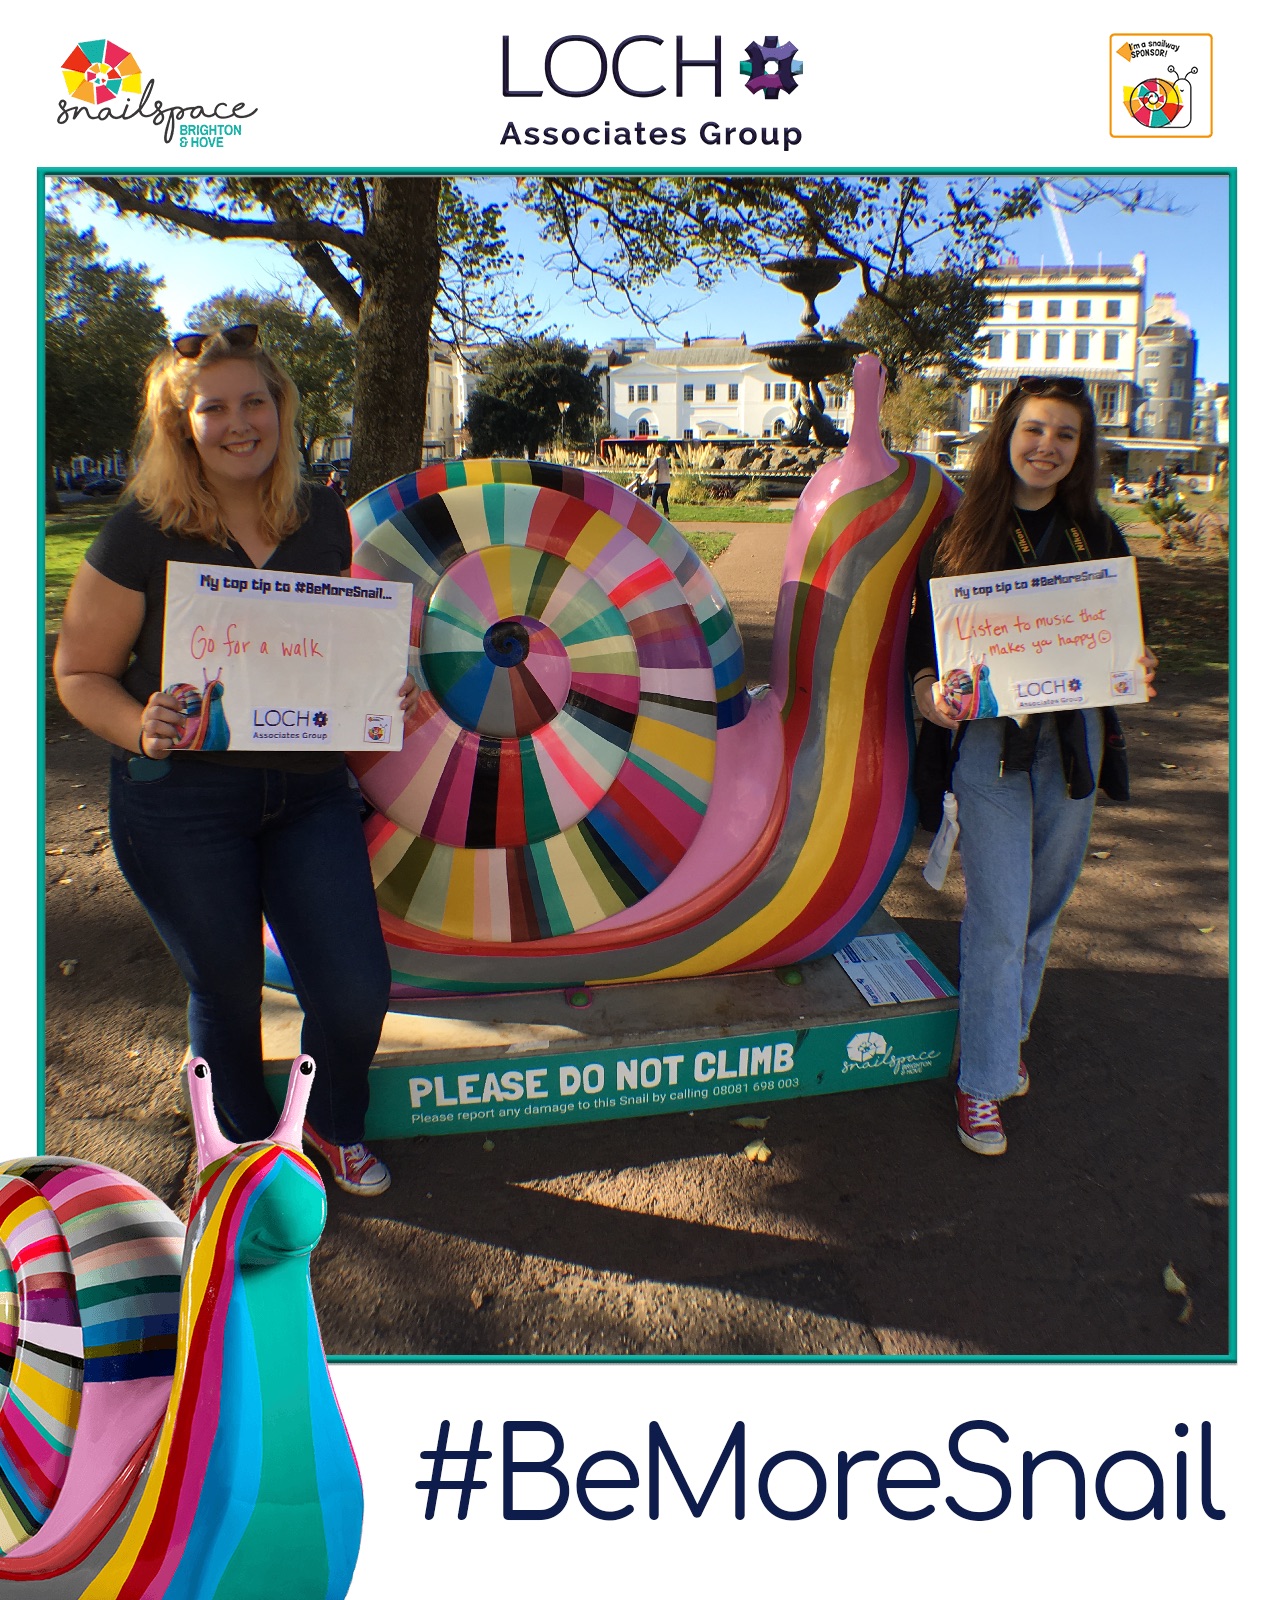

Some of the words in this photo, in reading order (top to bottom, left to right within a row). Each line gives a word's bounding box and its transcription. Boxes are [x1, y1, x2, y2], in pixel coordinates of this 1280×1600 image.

[1015, 528, 1031, 553] Nikon
[1070, 527, 1086, 552] Nikon
[200, 574, 220, 591] My
[223, 577, 248, 592] top
[252, 579, 272, 594] tip
[275, 580, 291, 593] to
[295, 581, 393, 600] #BeMoreSnail...
[954, 586, 970, 599] My
[972, 585, 993, 597] top
[995, 582, 1012, 594] tip
[1014, 580, 1028, 590] to
[956, 616, 1008, 641] Listen
[1013, 615, 1031, 633] to
[1036, 613, 1075, 629] music
[1079, 608, 1107, 623] that
[190, 625, 215, 660] Go
[223, 623, 251, 658] for
[260, 641, 269, 655] a
[281, 637, 324, 658] walk
[1057, 631, 1097, 650] happy
[1017, 680, 1066, 698] LOCH
[253, 709, 310, 727] LOCH
[252, 731, 300, 739] Associates
[302, 731, 328, 741] Group
[841, 1045, 941, 1076] snailspace
[408, 1068, 549, 1108] PLEASE
[559, 1063, 605, 1096] DO
[616, 1054, 685, 1092] NOT
[694, 1042, 795, 1083] CLIMB
[411, 1112, 454, 1124] Please
[457, 1108, 495, 1122] report
[499, 1107, 521, 1119] any
[524, 1103, 575, 1115] damage
[578, 1099, 590, 1110] to
[594, 1097, 616, 1108] this
[619, 1092, 649, 1106] Snail
[652, 1090, 667, 1103] by
[669, 1087, 709, 1101] calling
[713, 1083, 748, 1096] 08081
[753, 1081, 775, 1092] 698
[778, 1078, 800, 1089] 003
